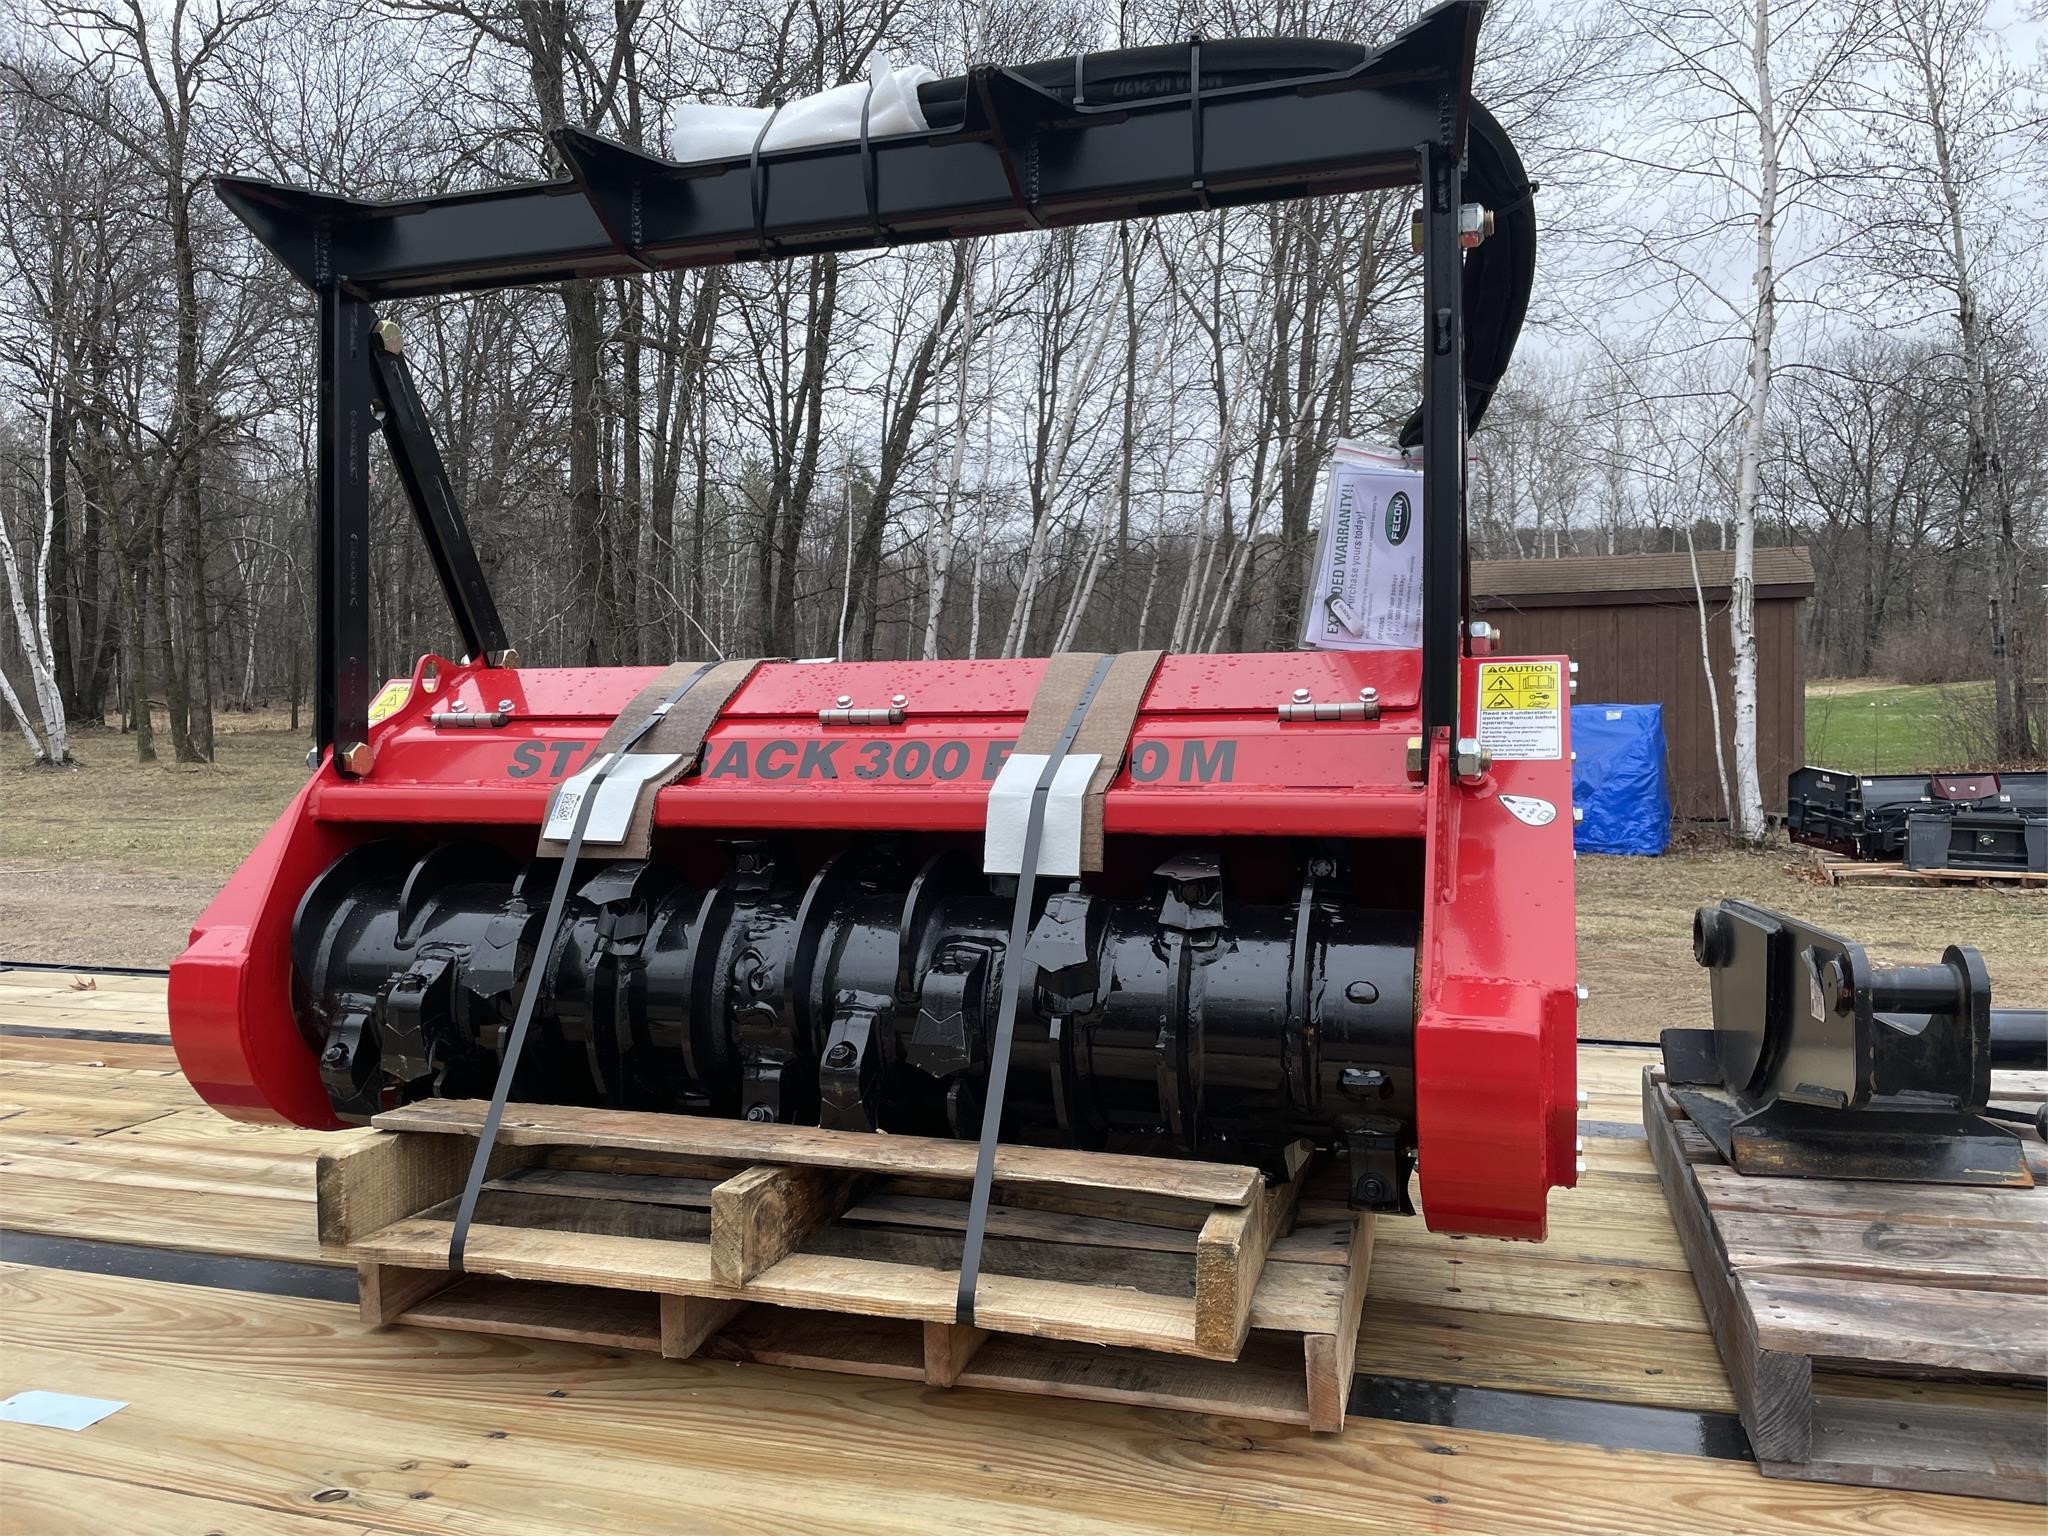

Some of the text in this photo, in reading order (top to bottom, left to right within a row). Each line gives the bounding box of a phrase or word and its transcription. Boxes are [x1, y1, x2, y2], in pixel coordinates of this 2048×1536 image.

[1334, 484, 1354, 566] WARRANTY!!
[1391, 500, 1403, 539] FECON
[1347, 511, 1366, 610] Purchase yours today!
[1327, 569, 1345, 634] EXDED
[1498, 665, 1553, 673] CAUTION
[507, 741, 847, 779] STACK
[854, 740, 971, 781] 300
